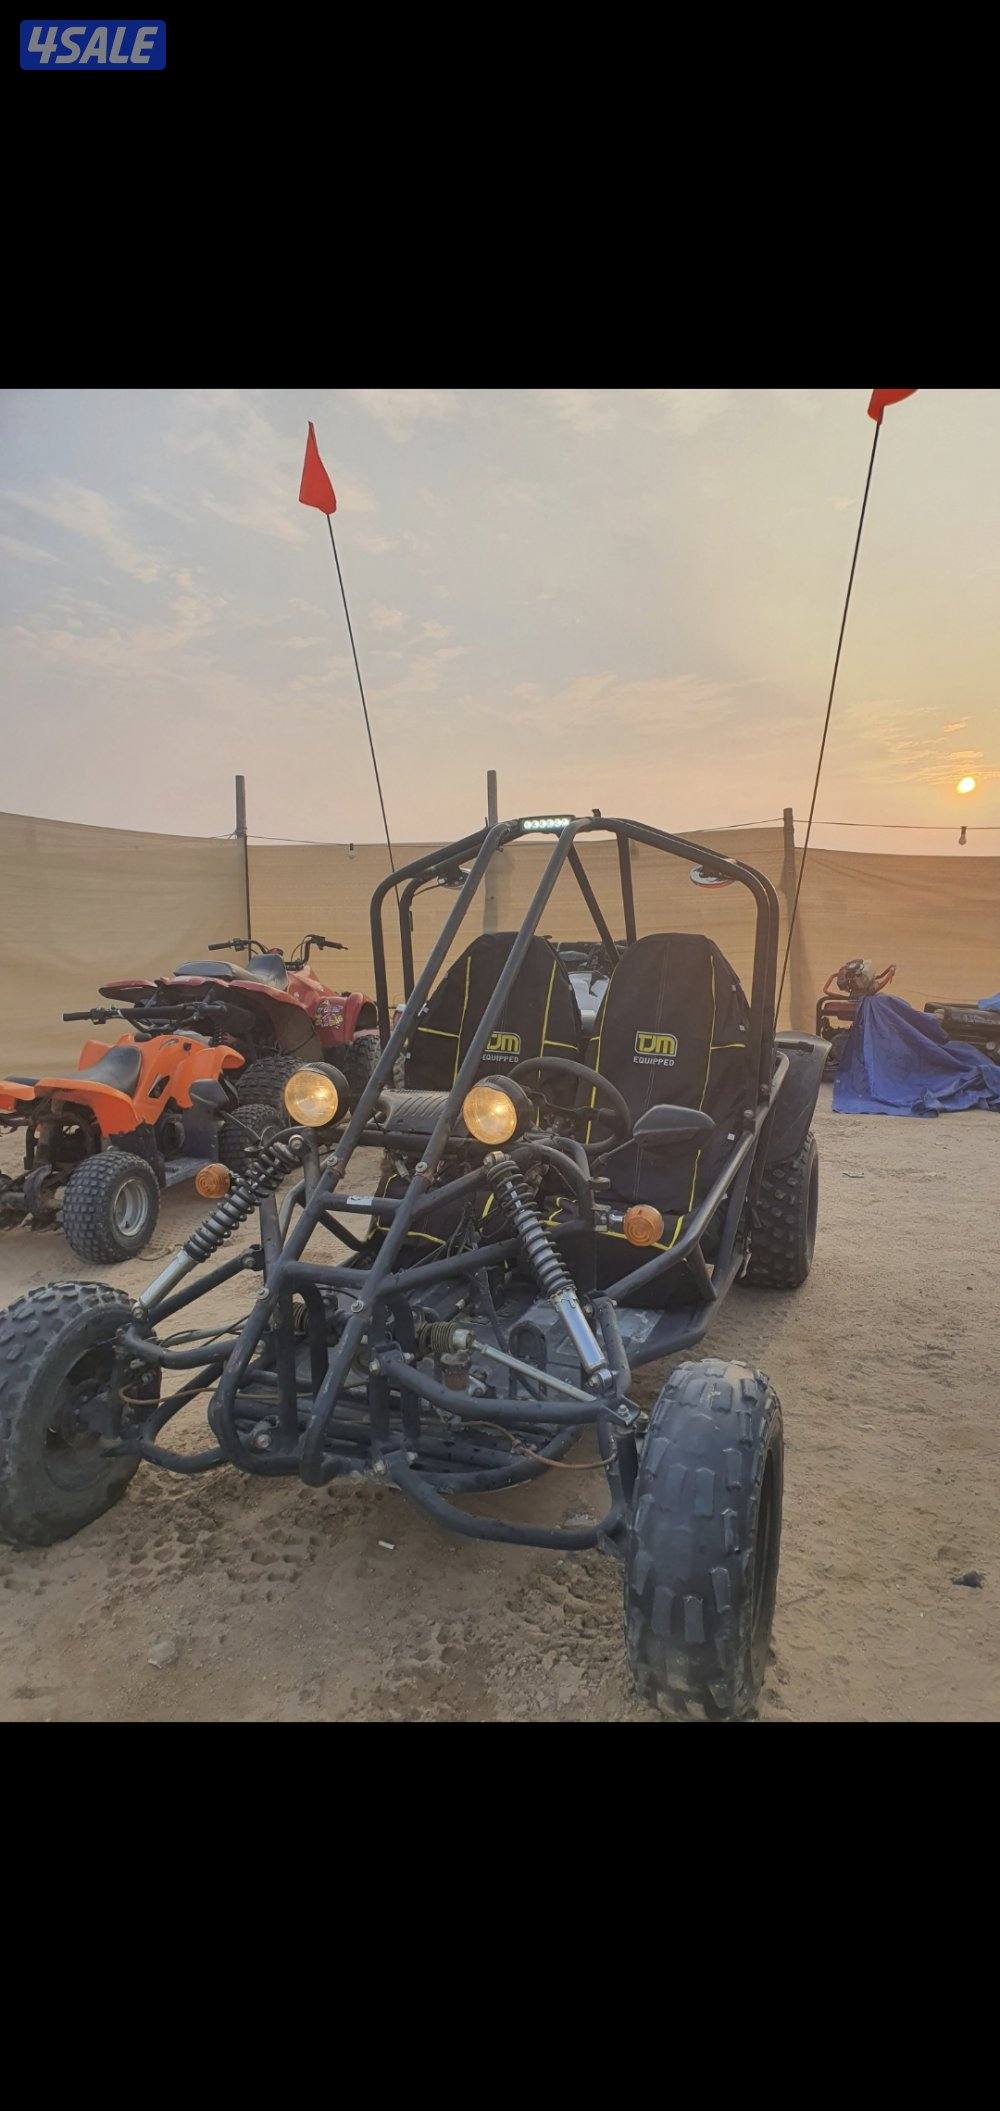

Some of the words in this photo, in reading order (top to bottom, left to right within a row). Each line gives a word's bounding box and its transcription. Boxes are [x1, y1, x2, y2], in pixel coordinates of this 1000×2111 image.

[637, 1033, 676, 1055] TJM
[482, 1053, 519, 1063] EQUIPPED
[633, 1056, 675, 1067] EQUIPPED
